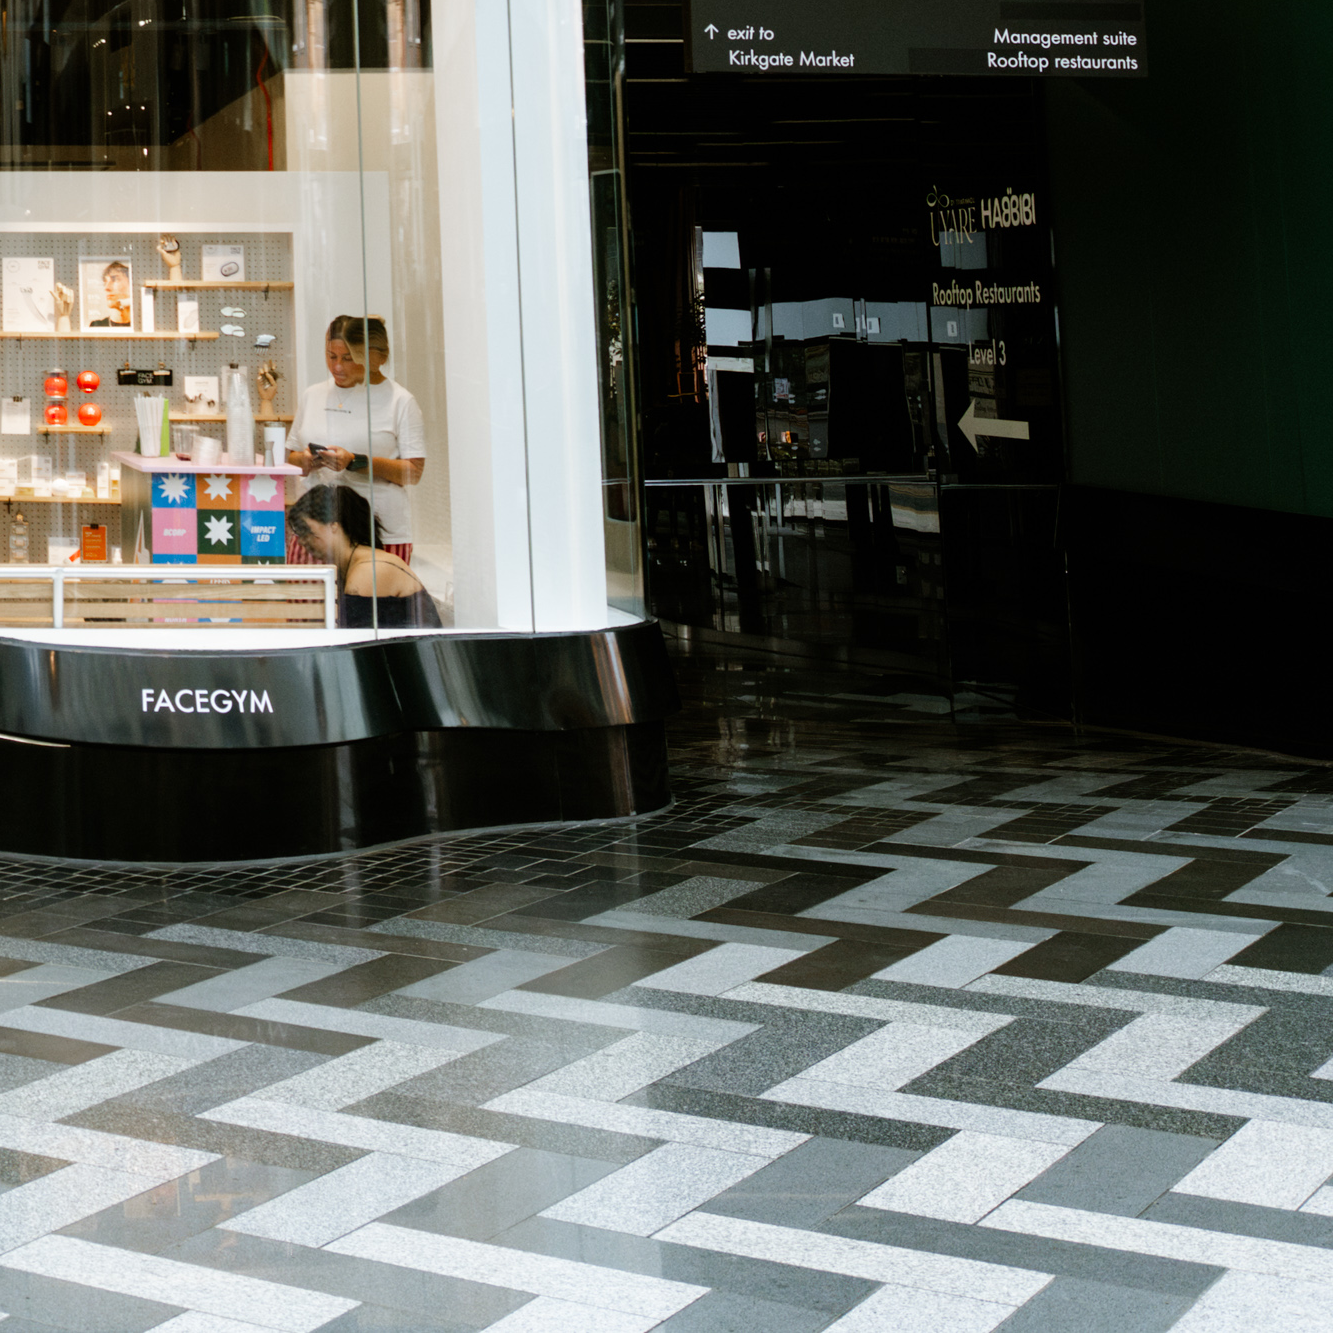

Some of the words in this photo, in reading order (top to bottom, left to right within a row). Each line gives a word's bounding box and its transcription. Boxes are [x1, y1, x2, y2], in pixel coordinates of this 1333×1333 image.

[727, 25, 757, 42] exit
[760, 26, 775, 41] to
[993, 28, 1099, 50] Management
[1102, 30, 1137, 47] suite
[728, 49, 795, 71] Kirkgate
[799, 50, 855, 68] Market
[987, 50, 1051, 72] Rooftop
[1054, 51, 1139, 70] restaurants
[932, 279, 973, 311] Rooftop
[975, 280, 1041, 305] Restaurants
[969, 338, 997, 366] Level
[998, 341, 1007, 366] 3
[250, 526, 276, 534] IMPACT
[141, 688, 274, 715] FACEGYM
